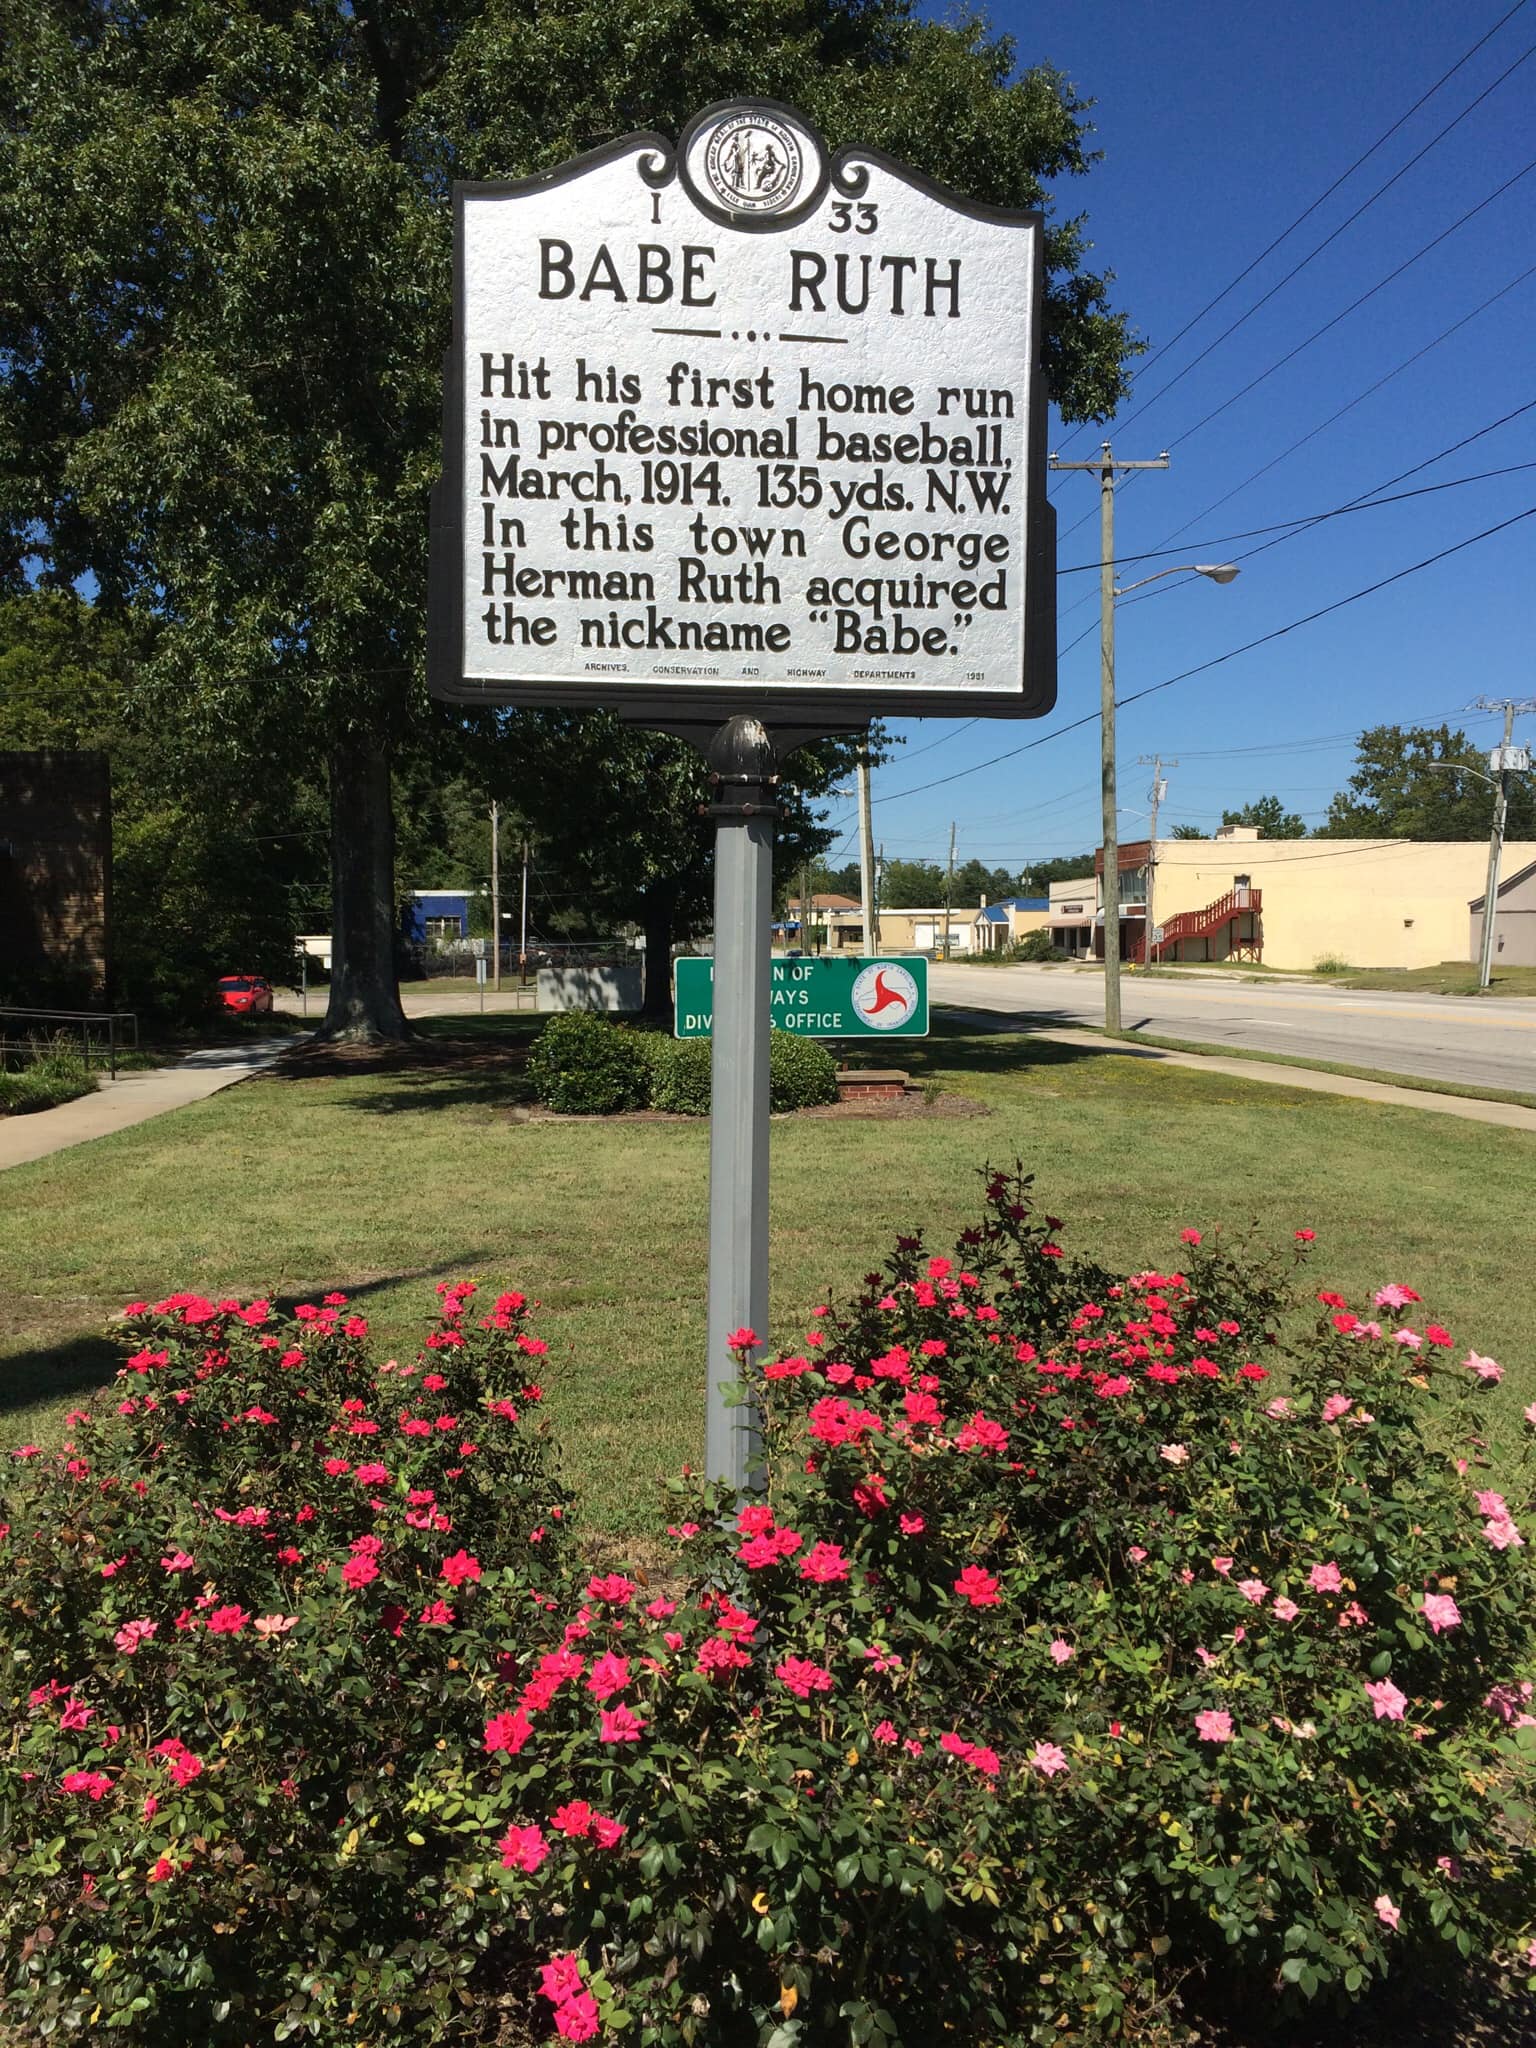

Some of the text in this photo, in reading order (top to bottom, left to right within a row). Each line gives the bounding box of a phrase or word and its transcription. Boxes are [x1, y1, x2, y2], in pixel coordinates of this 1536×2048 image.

[828, 201, 878, 235] 33
[538, 238, 962, 318] BABE RUTH
[480, 352, 1015, 419] Hit his first home run
[480, 409, 1012, 469] in professional baseball,
[479, 452, 1012, 520] March, 1914. 135 yds. N.W.
[481, 503, 1010, 571] In this town George
[481, 551, 1008, 621] Herman Ruth acquired
[481, 602, 557, 646] the
[580, 605, 791, 653] nickname
[652, 665, 720, 676] CONSERVATION
[741, 667, 760, 676] AND
[786, 668, 827, 677] HIGHWAY
[853, 670, 916, 679] DEPARTMENTS
[791, 966, 814, 981] OF
[784, 1013, 842, 1029] OFFICE
